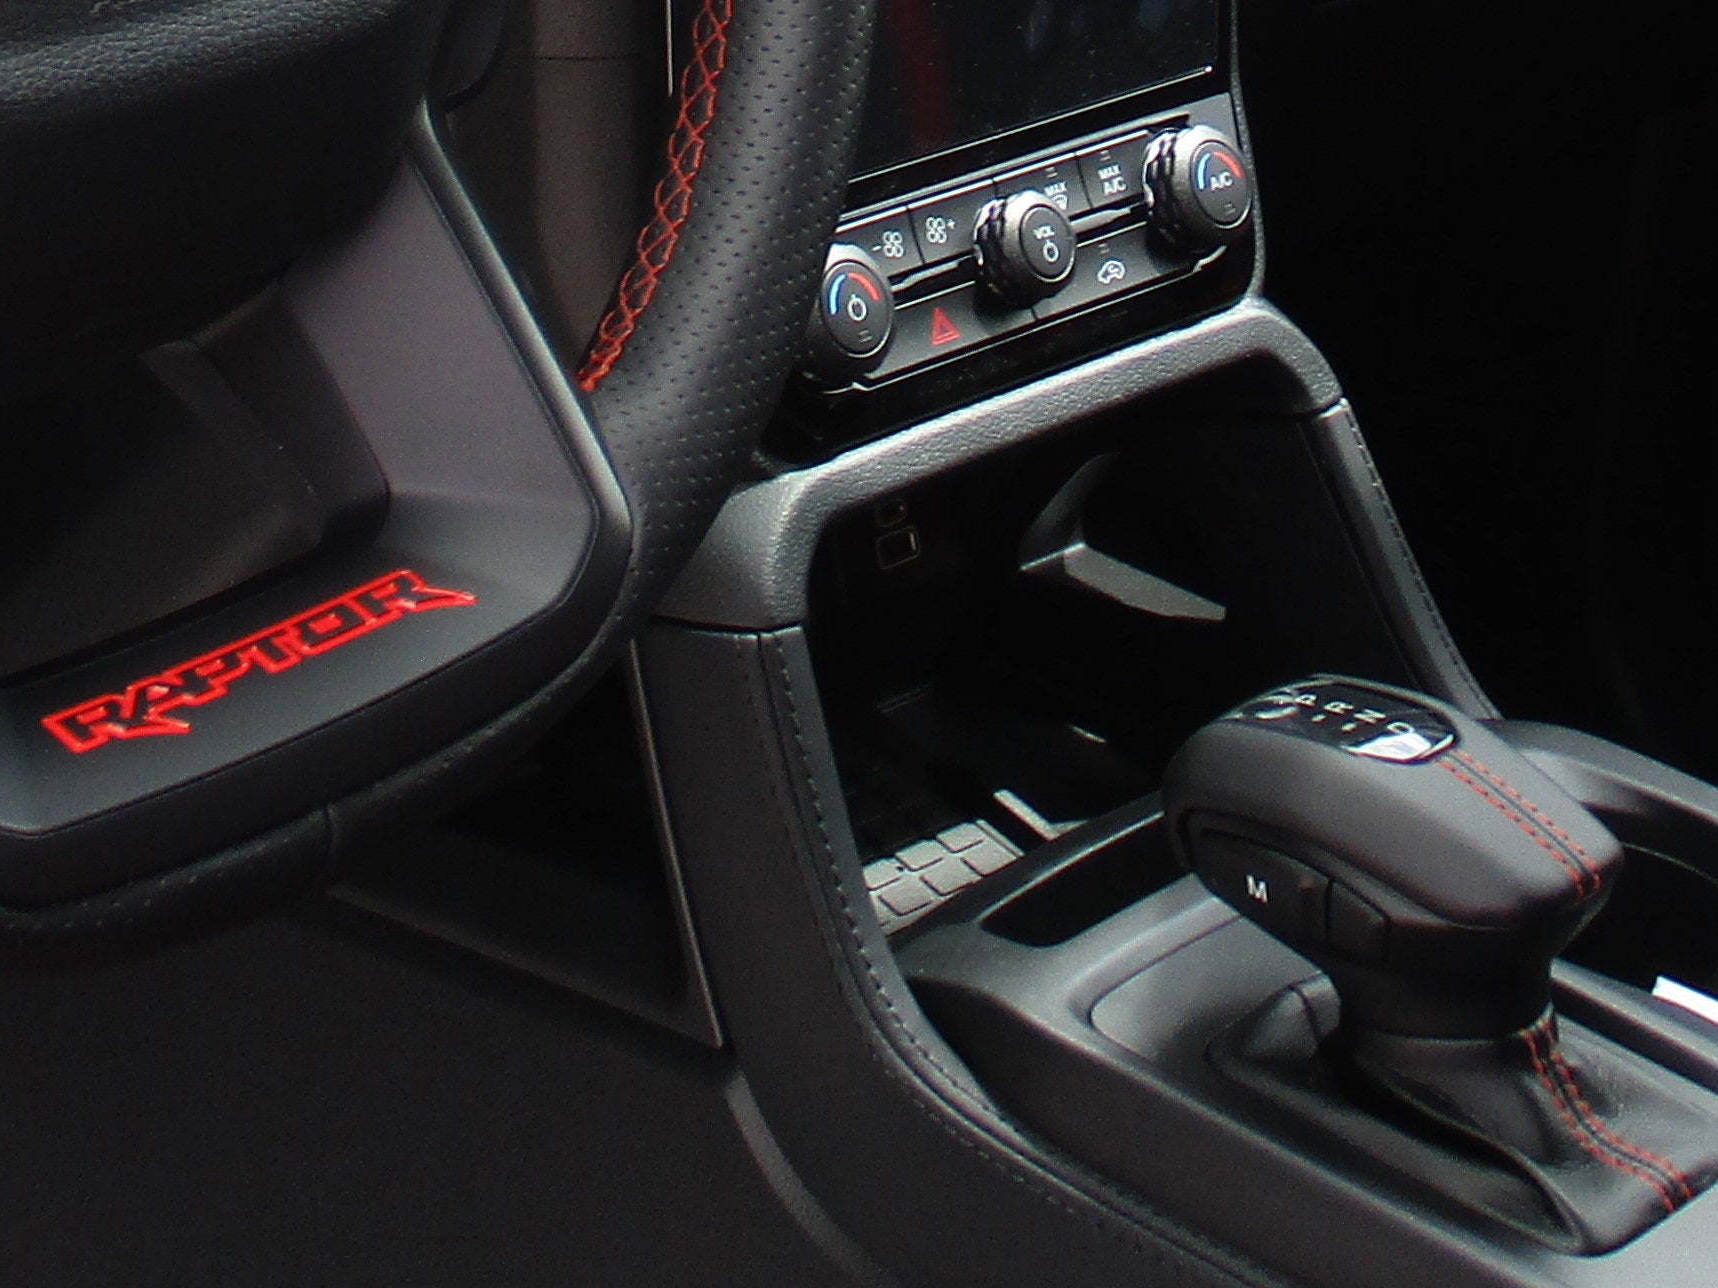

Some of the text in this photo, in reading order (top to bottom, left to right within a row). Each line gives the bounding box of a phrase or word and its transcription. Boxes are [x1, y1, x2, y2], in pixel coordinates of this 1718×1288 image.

[1098, 164, 1121, 180] MAX
[1210, 171, 1234, 191] A/C
[1044, 181, 1068, 196] MAX
[1103, 177, 1128, 196] A/C
[1032, 225, 1055, 240] VOL
[41, 568, 480, 754] RAPTOR
[1324, 701, 1354, 715] R
[1353, 709, 1387, 724] N
[1245, 874, 1269, 905] M
